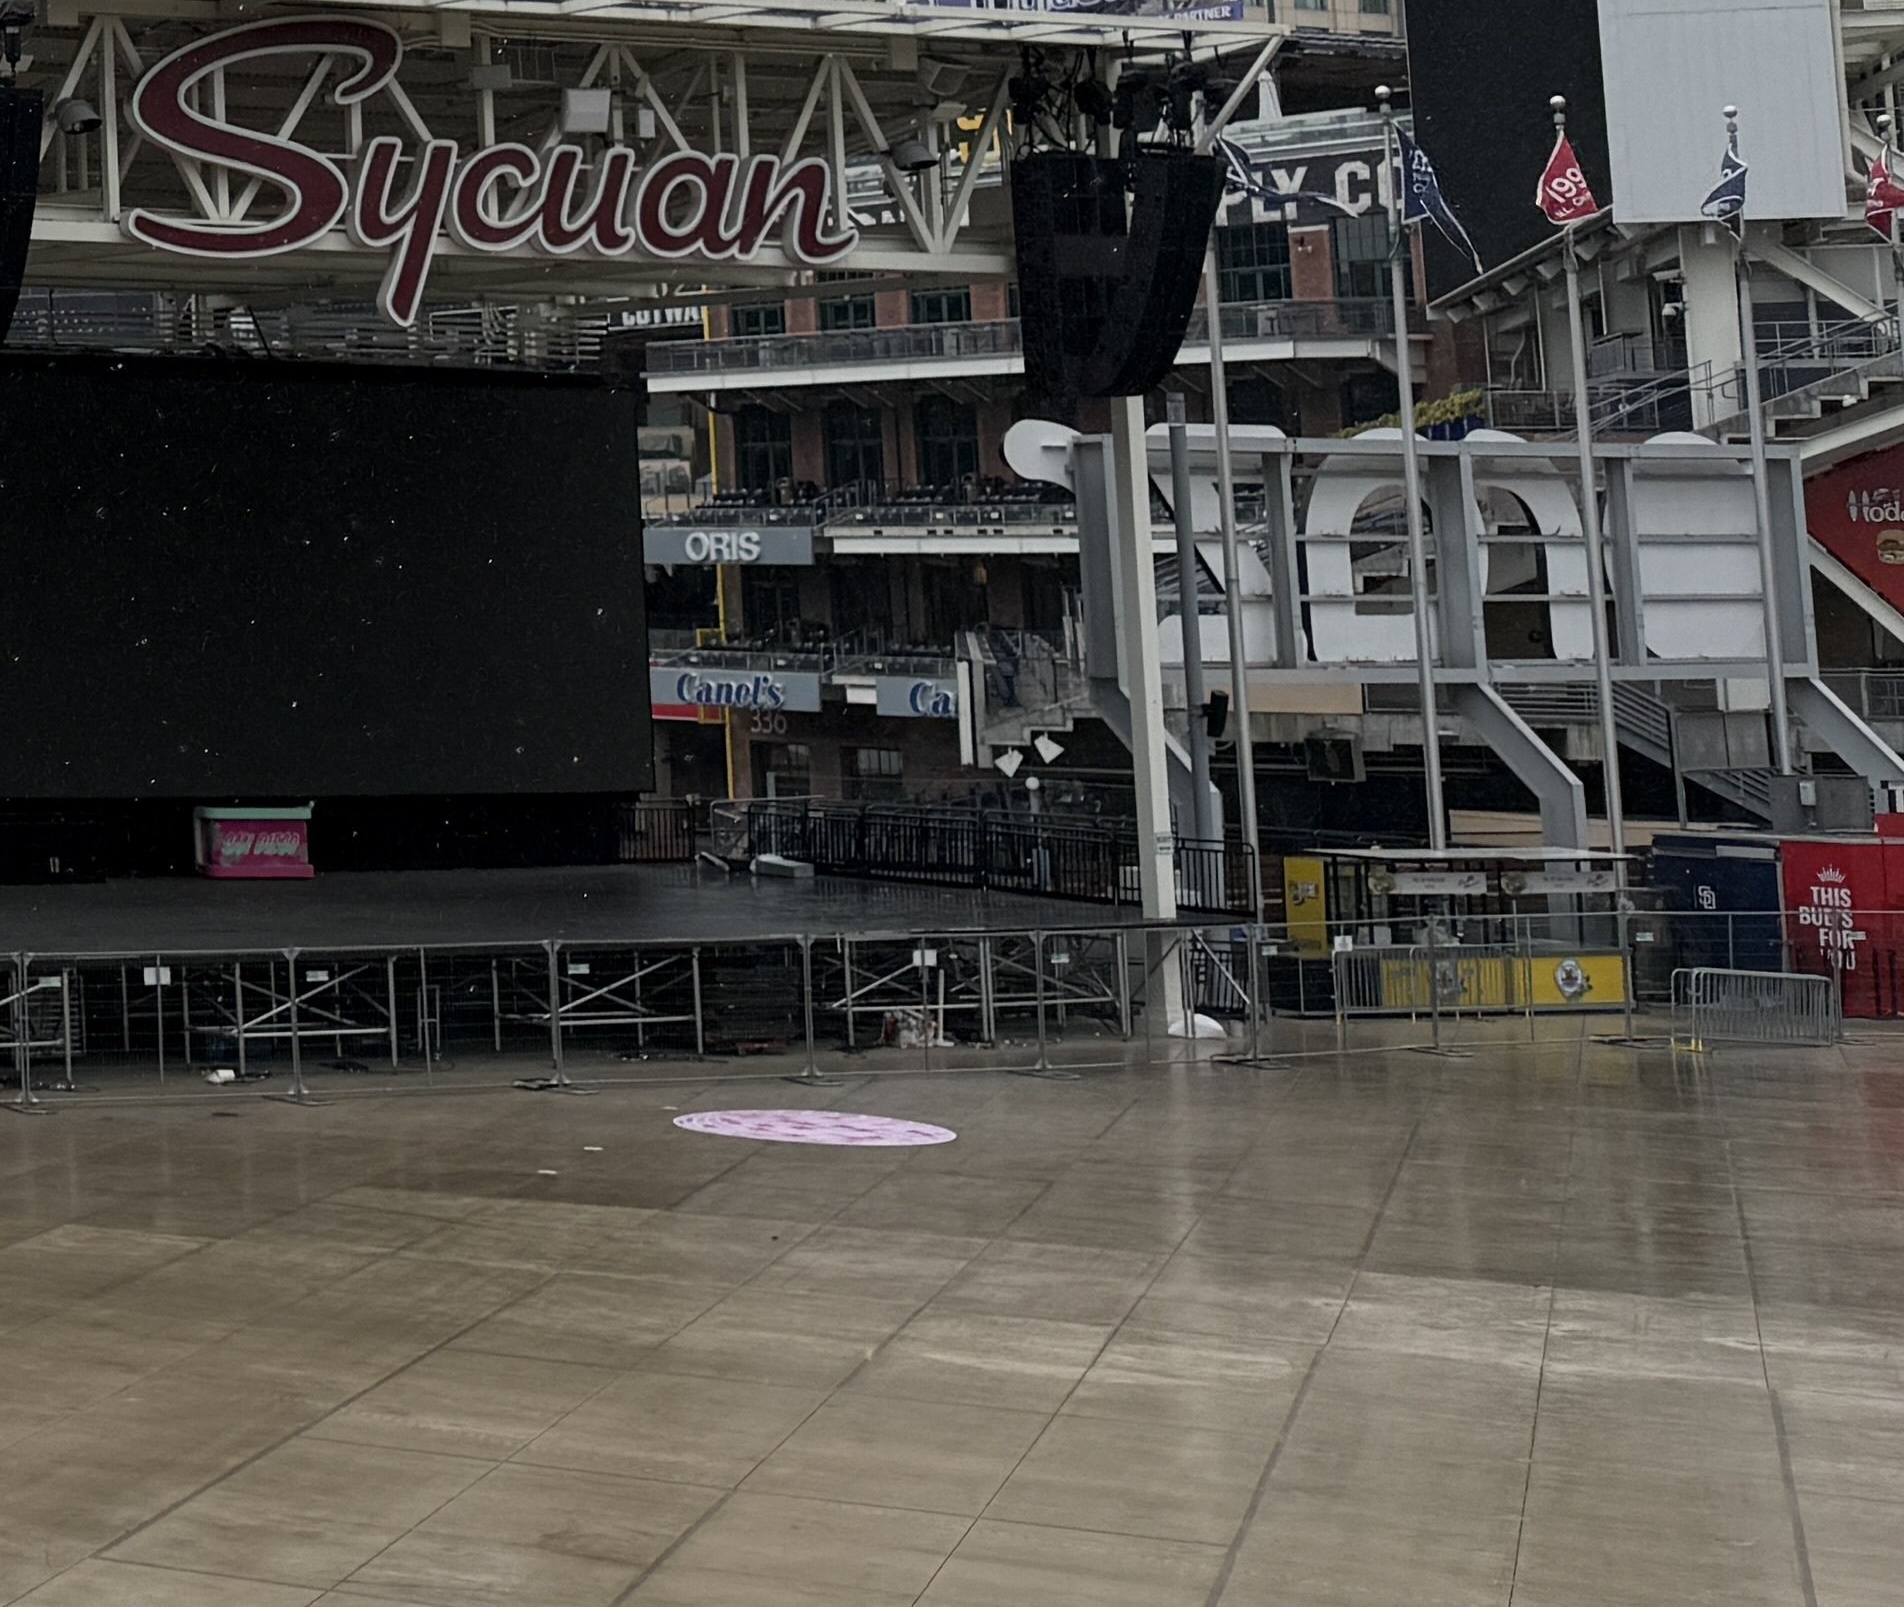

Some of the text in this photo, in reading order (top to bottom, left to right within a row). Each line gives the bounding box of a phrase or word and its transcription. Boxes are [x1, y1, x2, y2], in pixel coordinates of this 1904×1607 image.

[120, 13, 858, 326] Sycuan
[684, 531, 761, 562] ORIS
[677, 673, 785, 710] Canel's
[1810, 886, 1852, 908] THIS
